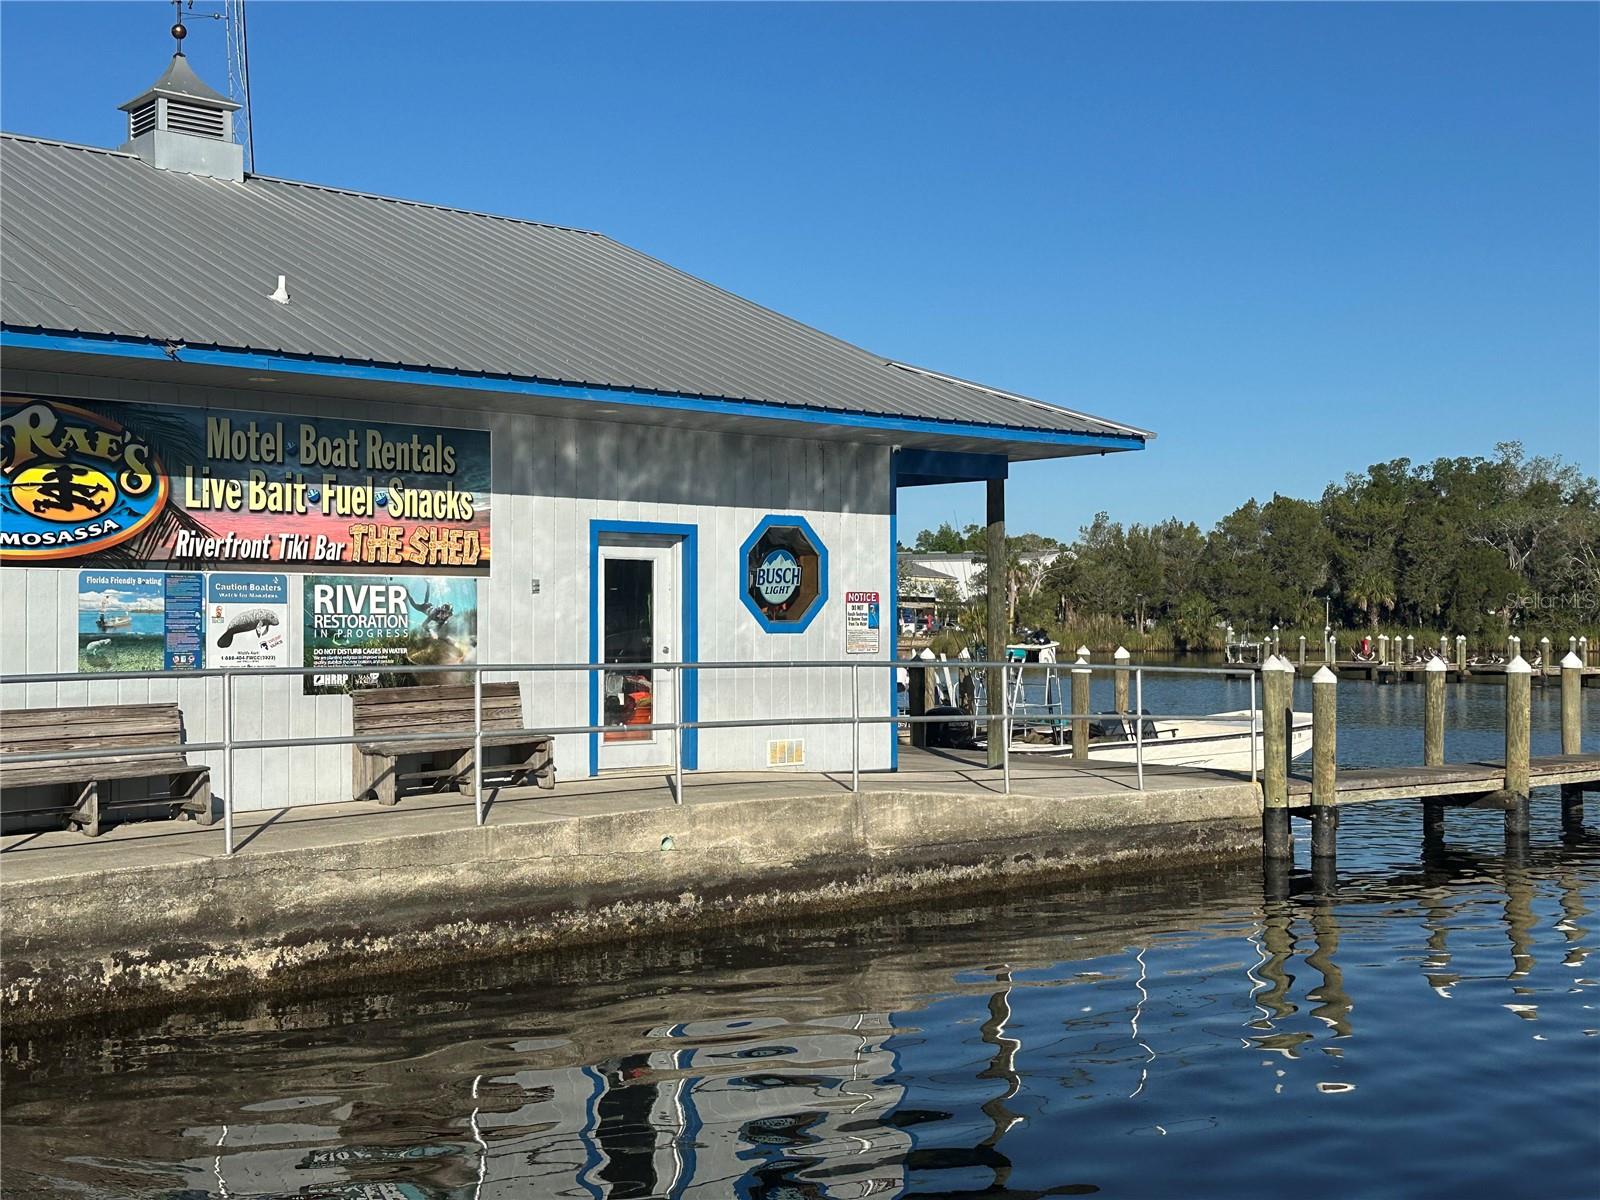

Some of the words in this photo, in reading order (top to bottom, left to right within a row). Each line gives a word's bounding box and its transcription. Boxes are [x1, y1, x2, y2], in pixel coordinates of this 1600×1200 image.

[207, 416, 283, 463] Motel
[300, 423, 358, 469] Boat
[366, 429, 456, 474] Rentals
[185, 465, 242, 510] Live
[249, 469, 306, 514] Bait
[322, 473, 373, 517] Fuel
[387, 477, 473, 521] Snacks
[175, 529, 271, 559] Riverfront
[278, 533, 310, 560] Tiki
[314, 534, 346, 561] Bar
[349, 523, 403, 564] THE
[409, 526, 480, 566] SHED
[86, 576, 109, 585] Florida
[110, 576, 136, 586] Friendly
[757, 567, 800, 586] BUSCH
[215, 583, 248, 591] Caution
[249, 583, 282, 592] Boaters
[765, 585, 790, 595] LIGHT
[314, 584, 408, 614] RIVER
[848, 592, 877, 602] NOTICE
[314, 614, 408, 628] RESTORATION
[314, 629, 328, 638] IN
[337, 629, 409, 638] PROGRESS
